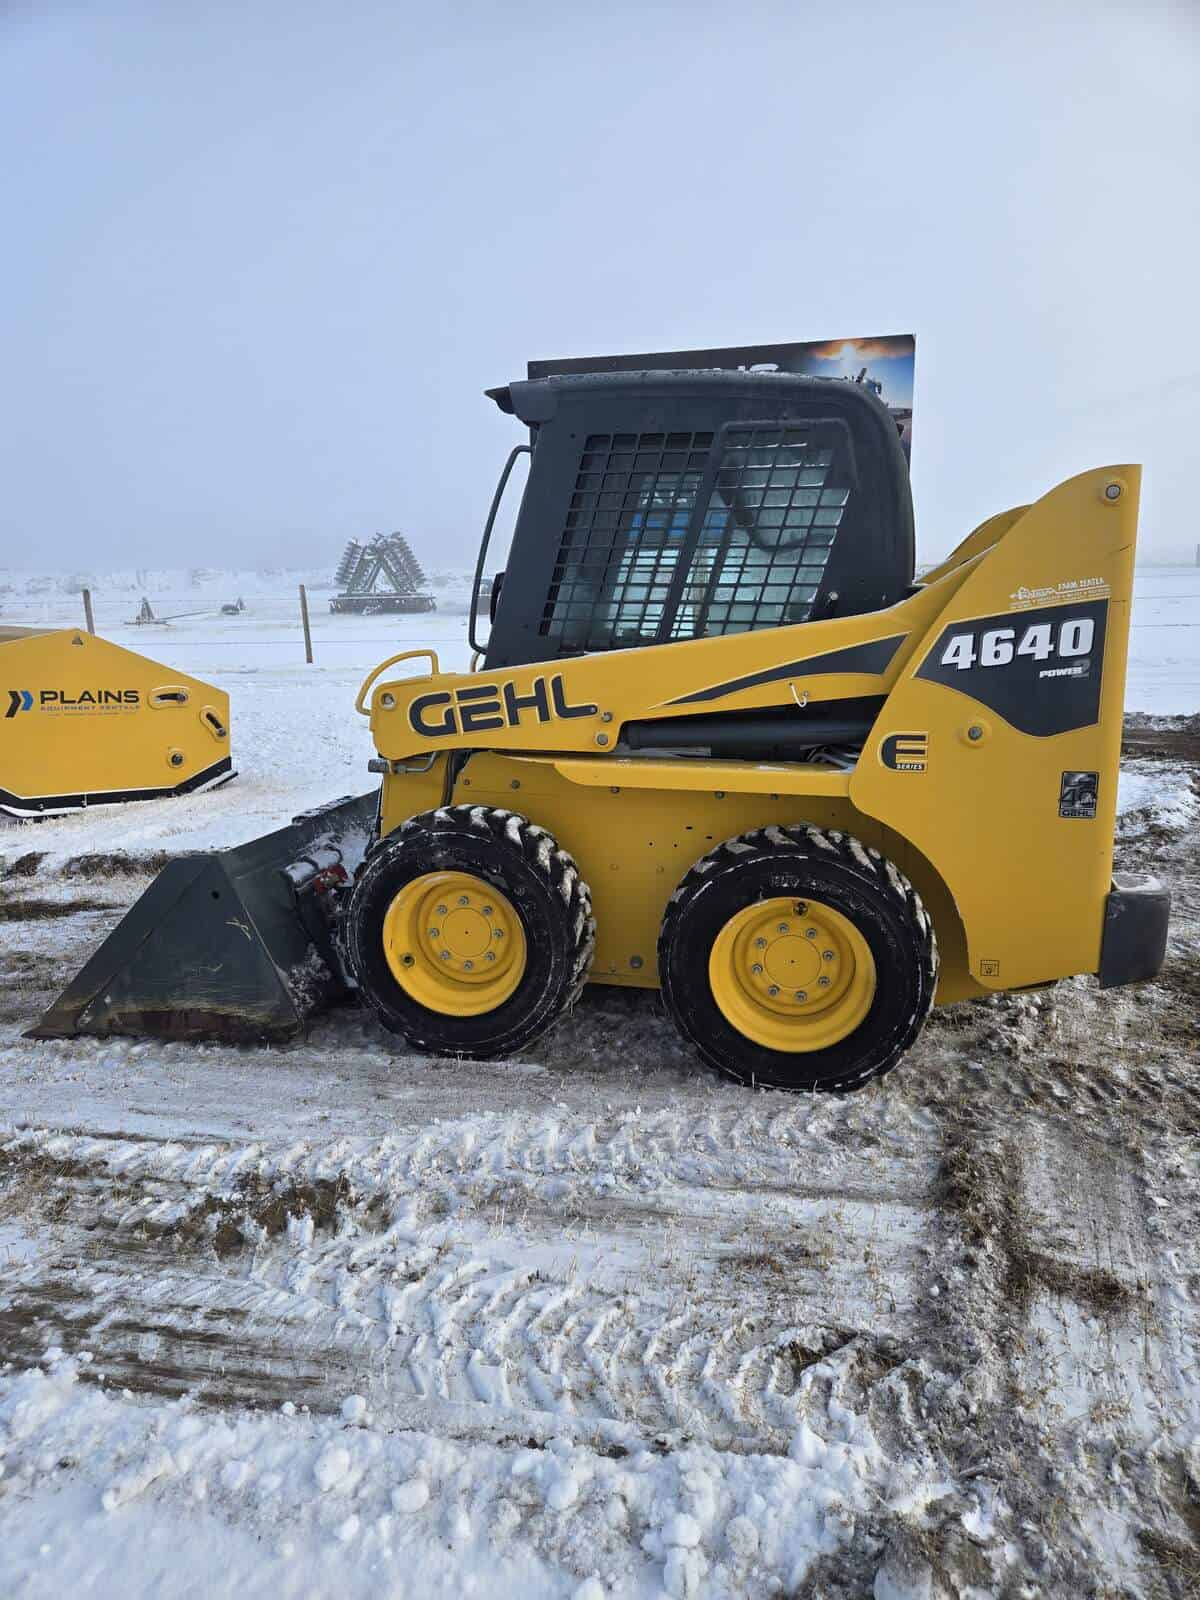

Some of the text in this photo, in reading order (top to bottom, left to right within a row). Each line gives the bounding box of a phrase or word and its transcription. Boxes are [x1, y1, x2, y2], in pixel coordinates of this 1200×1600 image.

[940, 618, 1095, 670] 4640
[39, 690, 140, 704] PLAINS
[408, 673, 599, 738] GEHL
